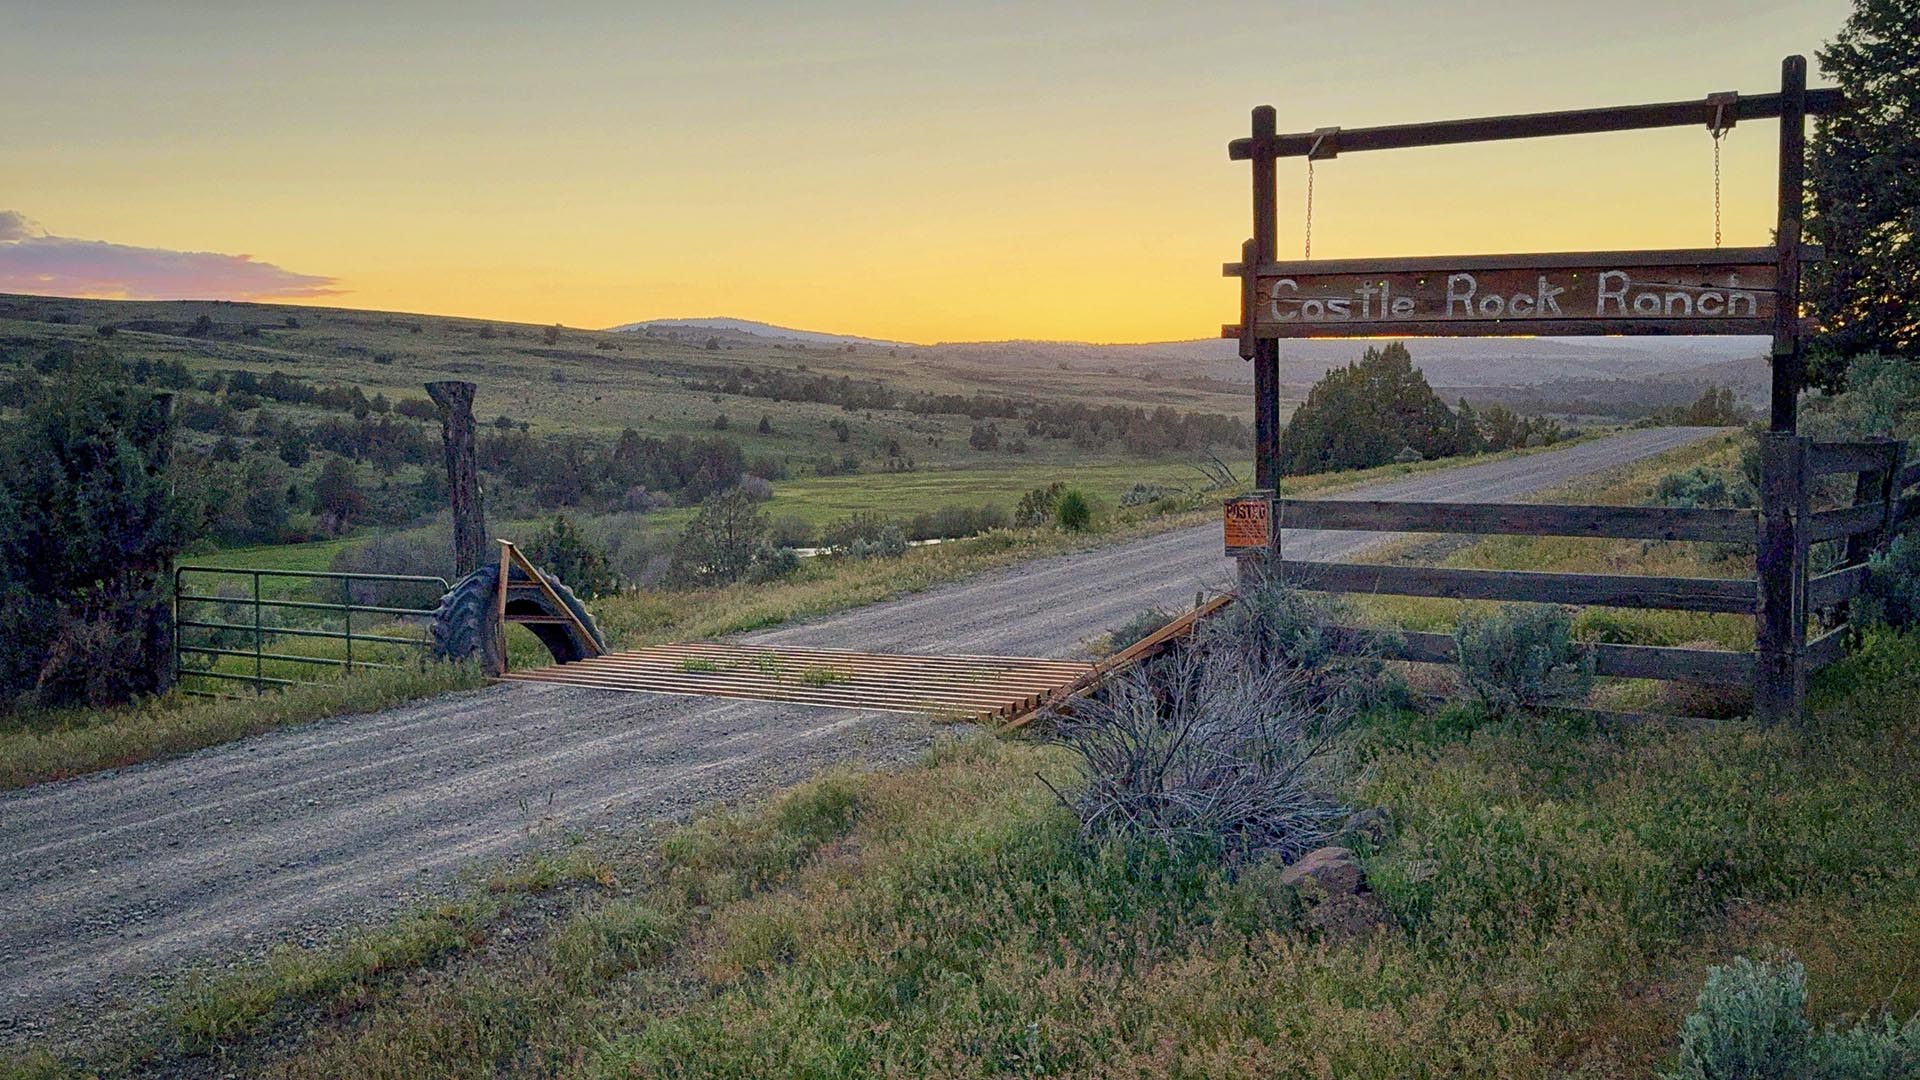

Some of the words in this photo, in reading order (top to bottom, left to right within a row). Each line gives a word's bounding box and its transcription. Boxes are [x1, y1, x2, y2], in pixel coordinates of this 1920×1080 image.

[1271, 278, 1415, 321] Castle
[1446, 273, 1564, 317] Rock
[1596, 270, 1757, 316] Ranch
